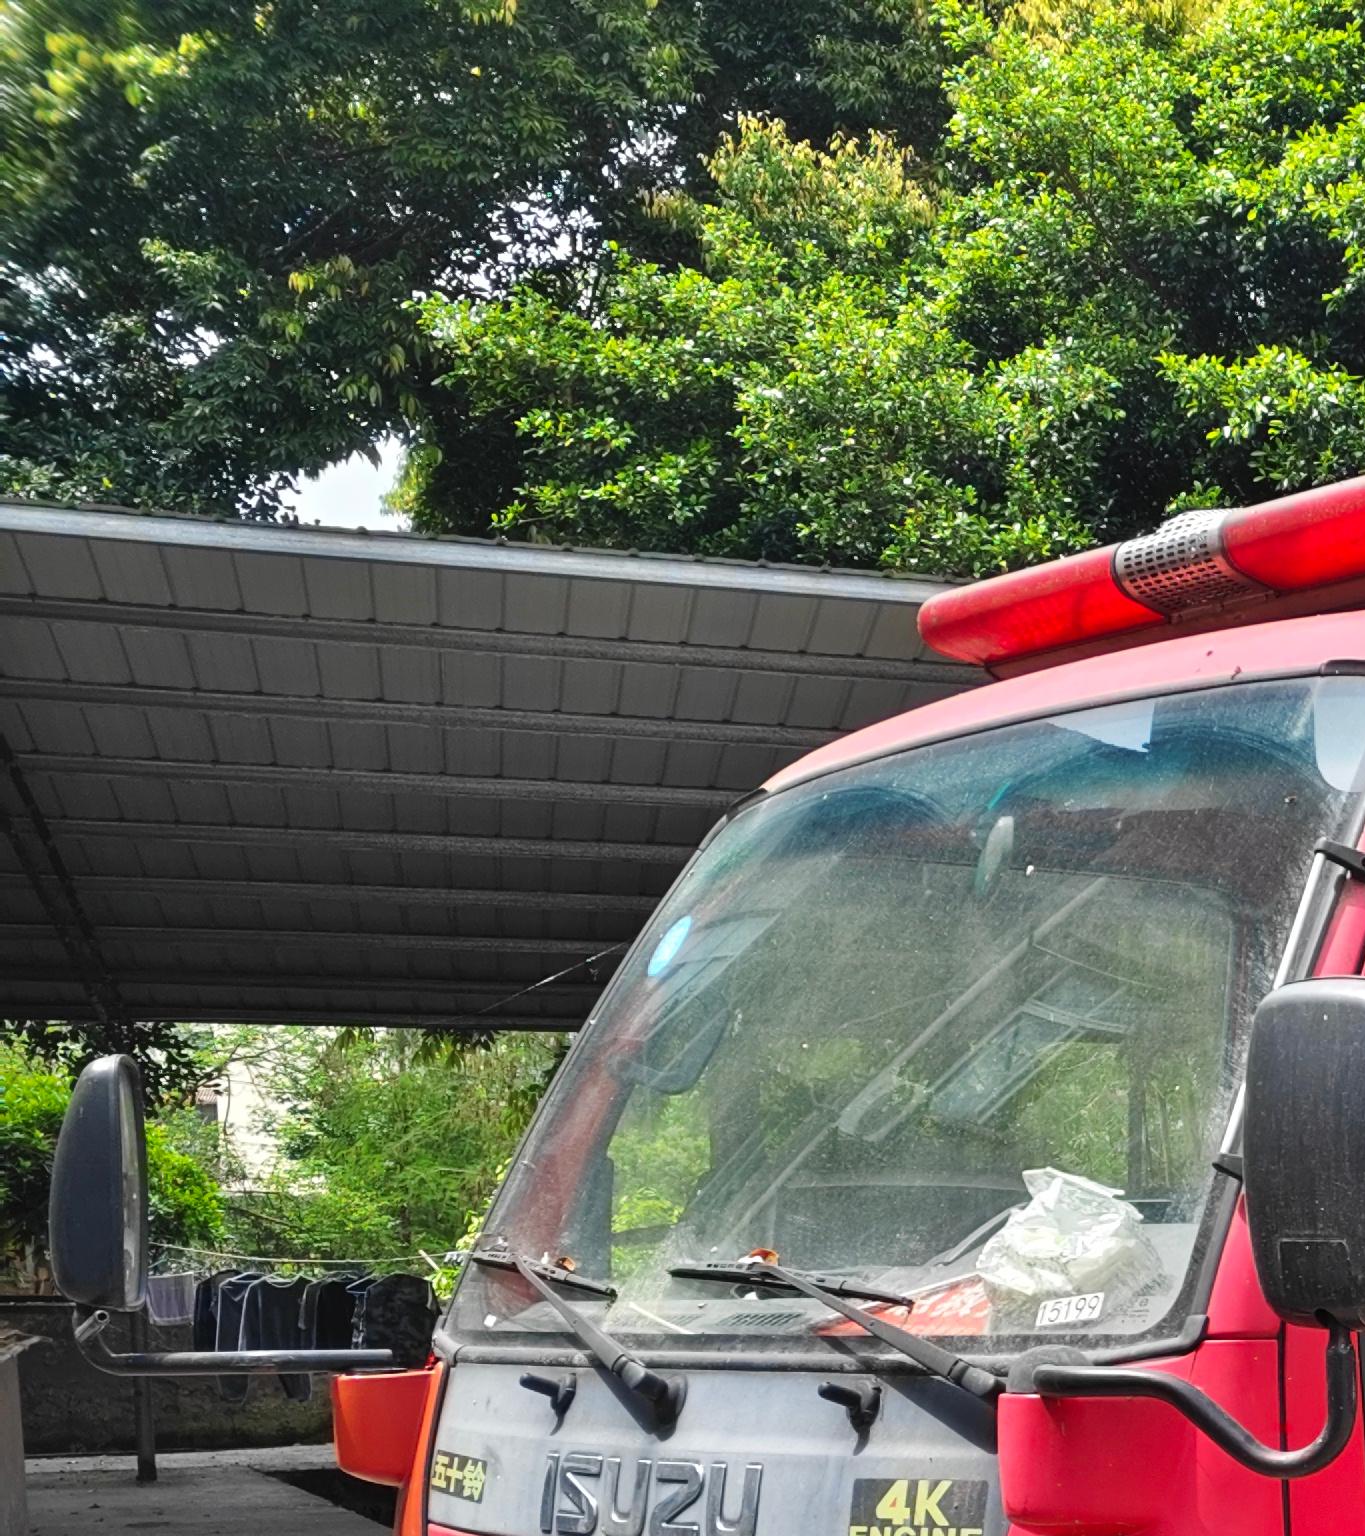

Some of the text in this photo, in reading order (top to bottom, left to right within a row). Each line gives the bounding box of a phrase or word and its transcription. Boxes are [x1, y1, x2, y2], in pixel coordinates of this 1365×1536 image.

[1038, 1295, 1100, 1323] 15199
[431, 1454, 485, 1501] 五十铃
[875, 1479, 953, 1526] 4K
